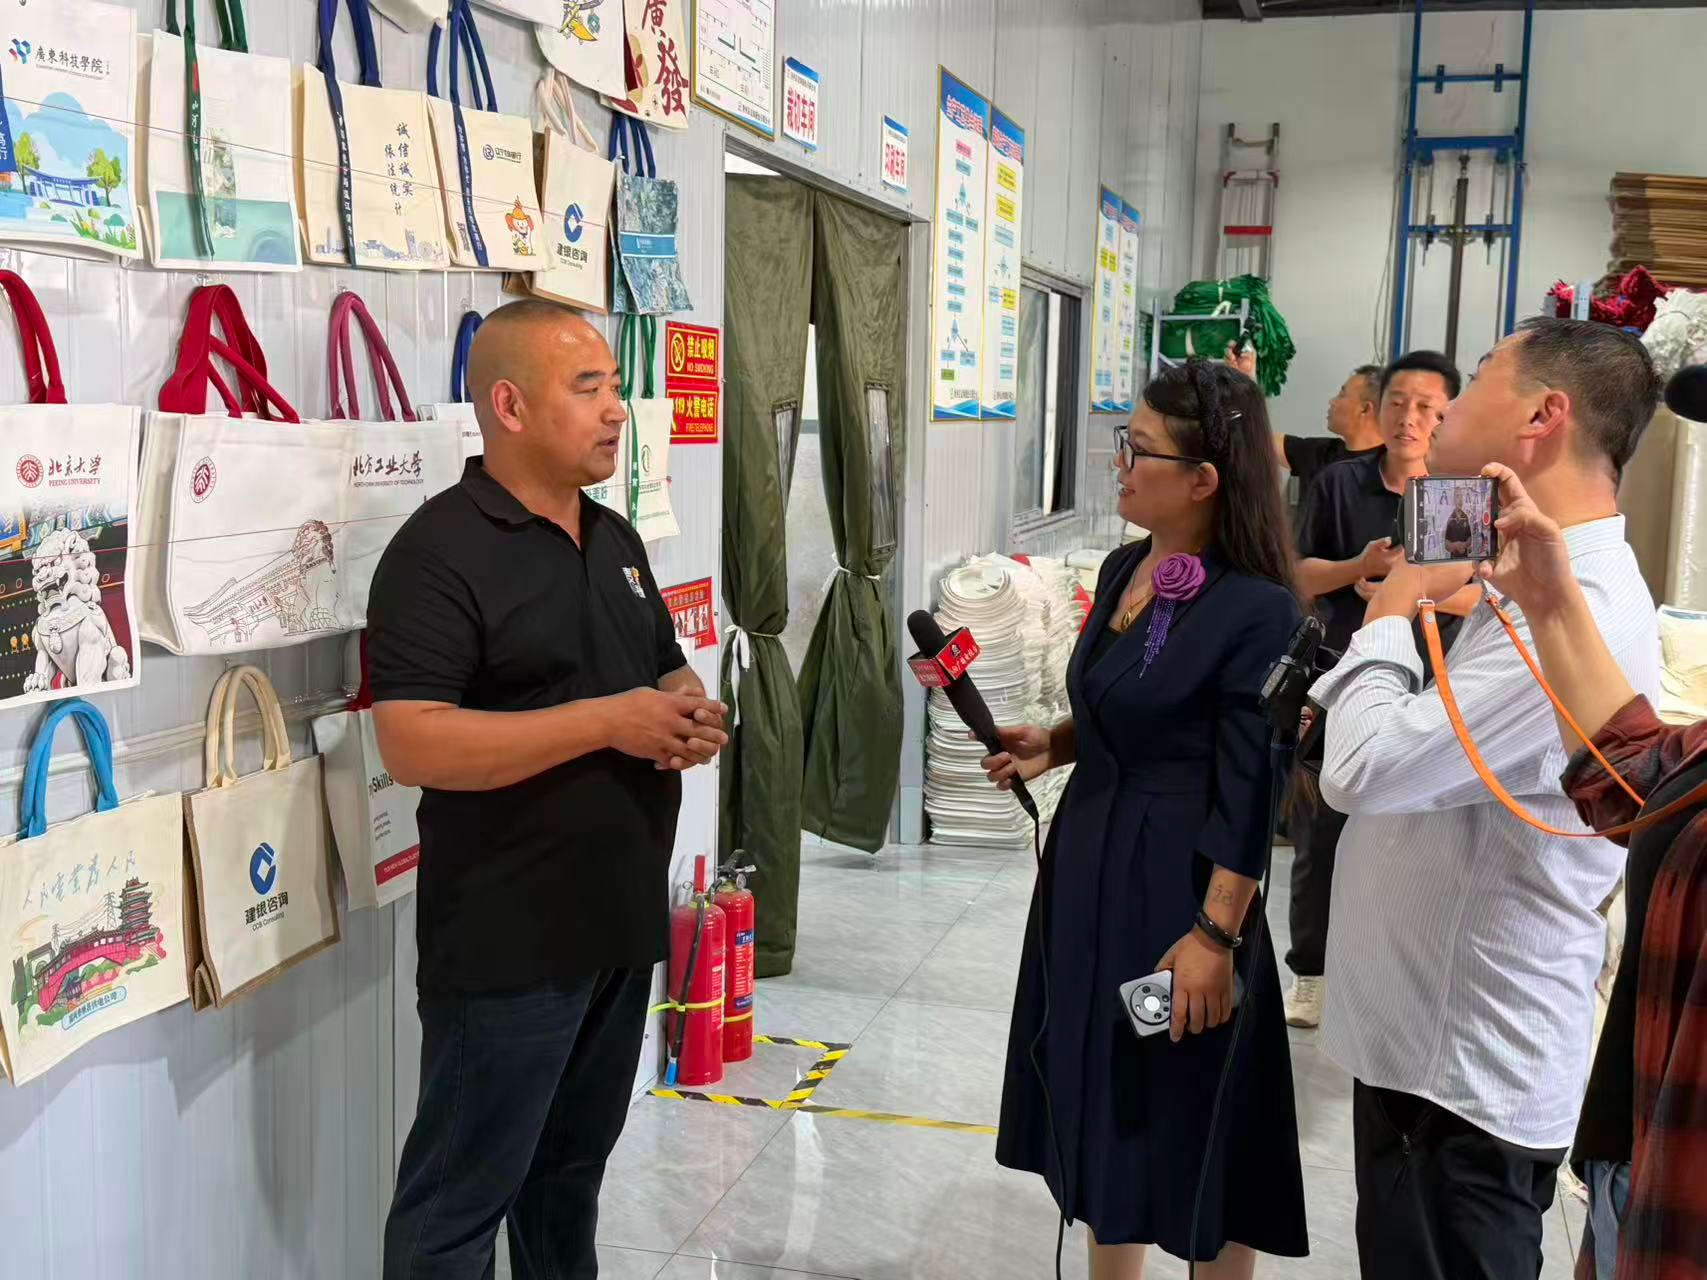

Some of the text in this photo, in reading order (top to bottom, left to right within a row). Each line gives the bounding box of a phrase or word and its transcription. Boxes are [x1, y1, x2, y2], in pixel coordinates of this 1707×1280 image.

[687, 335, 715, 361] 禁止吸烟
[686, 395, 715, 418] 火警电话
[244, 891, 289, 925] 建银咨询
